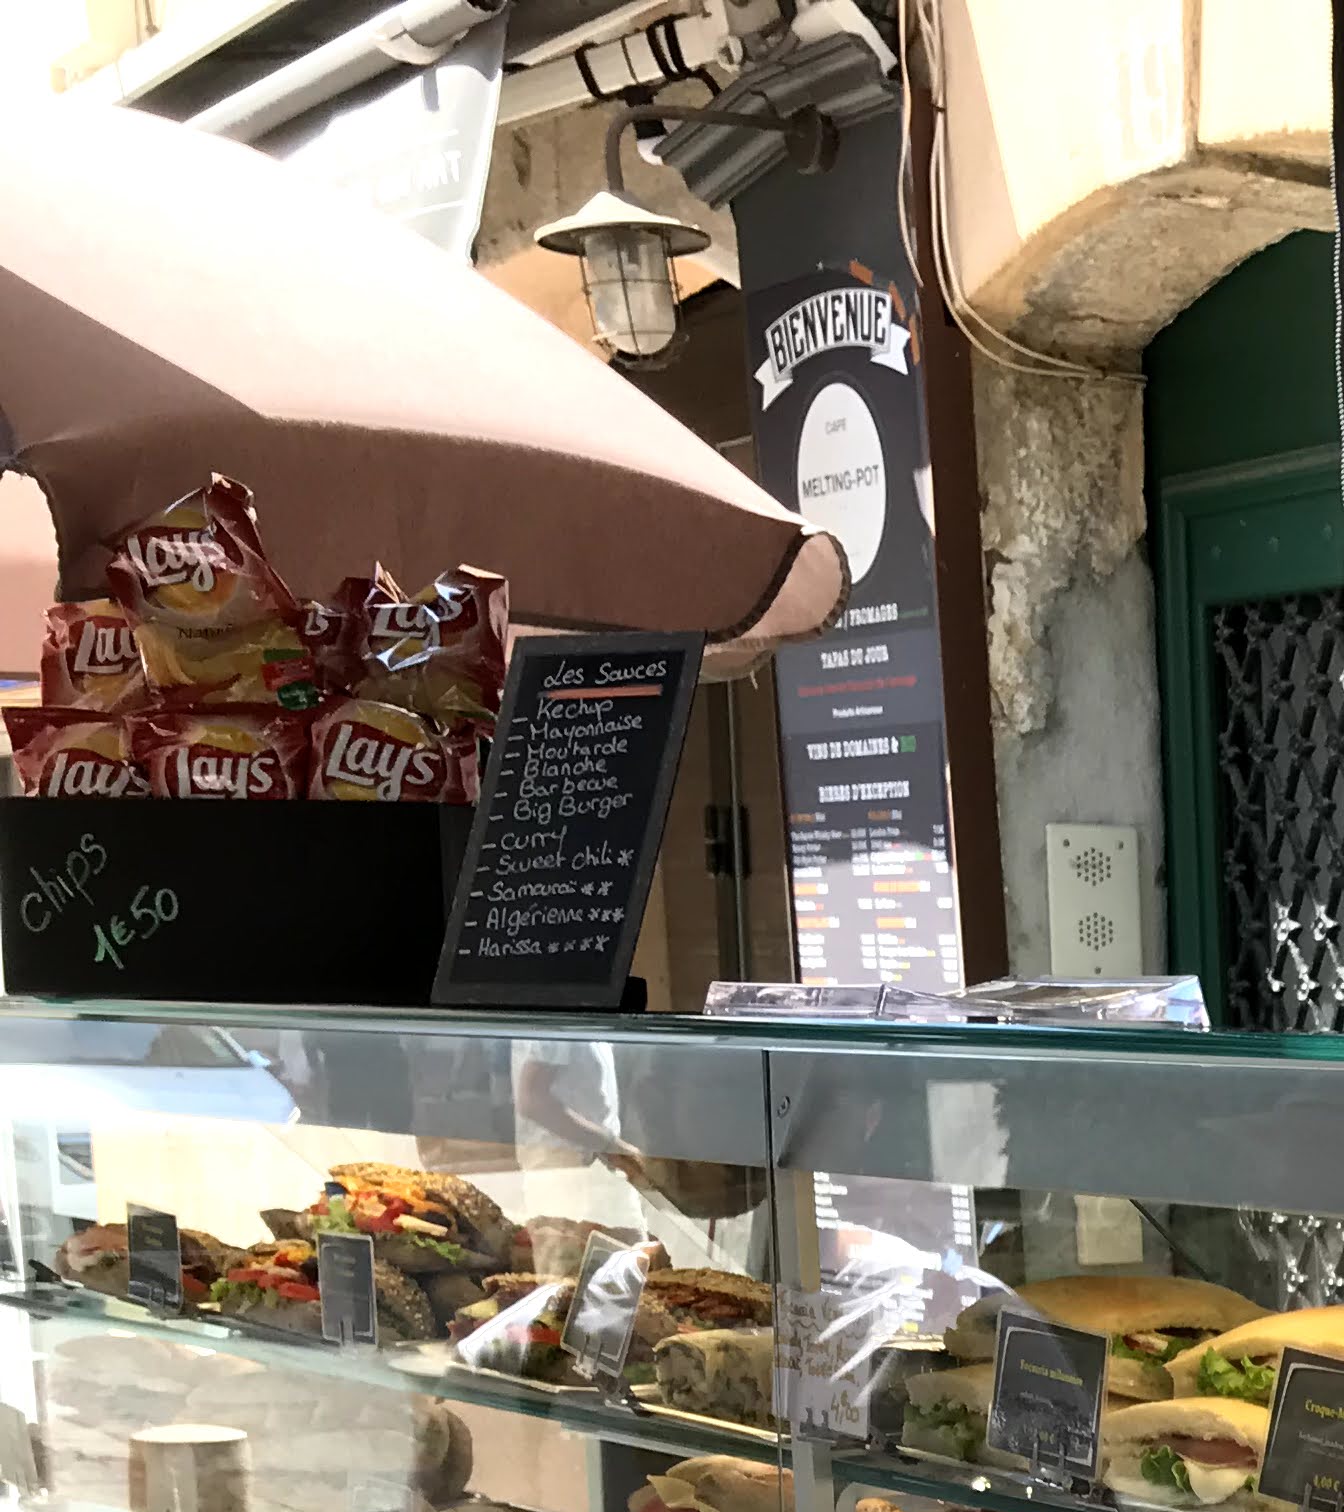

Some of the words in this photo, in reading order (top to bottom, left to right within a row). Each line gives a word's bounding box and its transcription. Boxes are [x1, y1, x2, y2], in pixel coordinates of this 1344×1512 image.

[770, 292, 889, 376] BIENVENUE
[802, 464, 880, 499] MELTING-POT
[544, 660, 585, 688] Les
[596, 659, 668, 686] Sauces
[526, 736, 629, 761] Moutarde
[513, 799, 551, 826] Big
[558, 793, 634, 820] Burger
[20, 832, 108, 932] Chips
